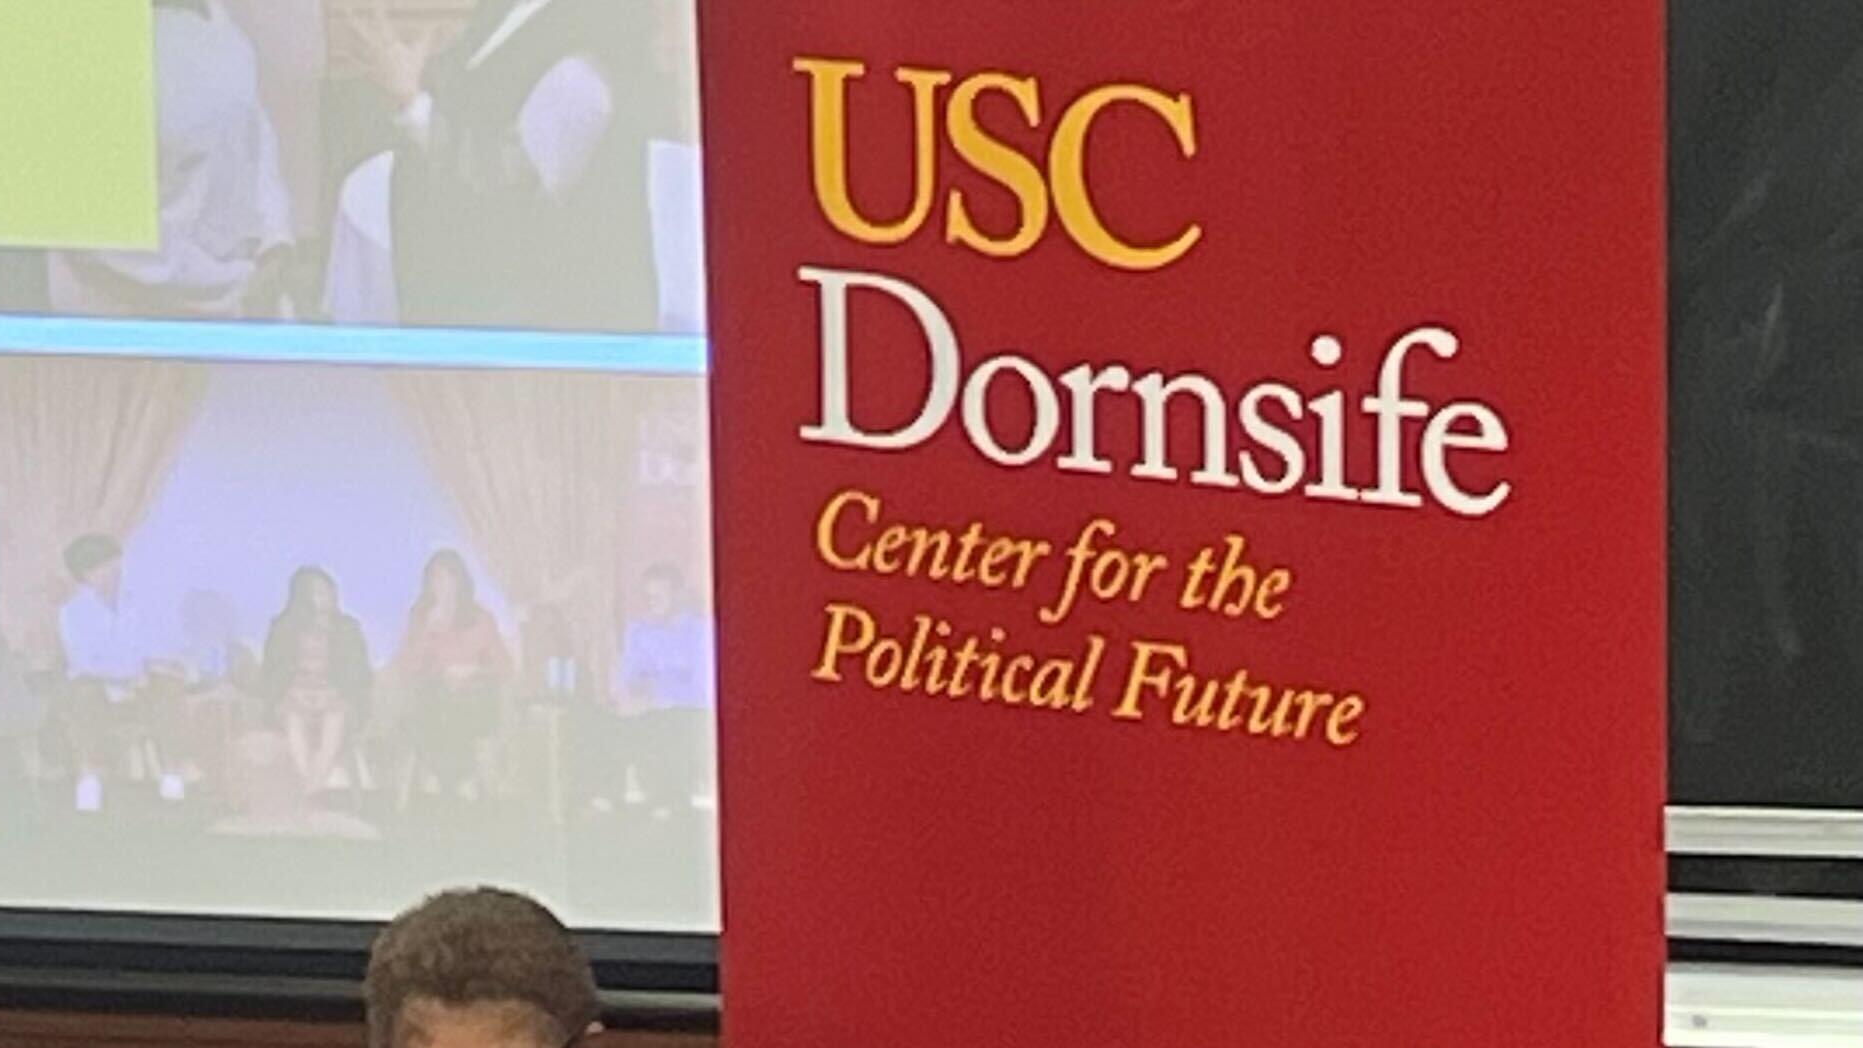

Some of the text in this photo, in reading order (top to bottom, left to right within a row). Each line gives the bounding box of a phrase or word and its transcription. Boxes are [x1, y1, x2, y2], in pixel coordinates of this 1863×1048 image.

[792, 56, 1202, 270] USC
[796, 265, 1512, 517] Dornsife
[816, 489, 1291, 624] Center for the
[811, 602, 1365, 746] Political Future
